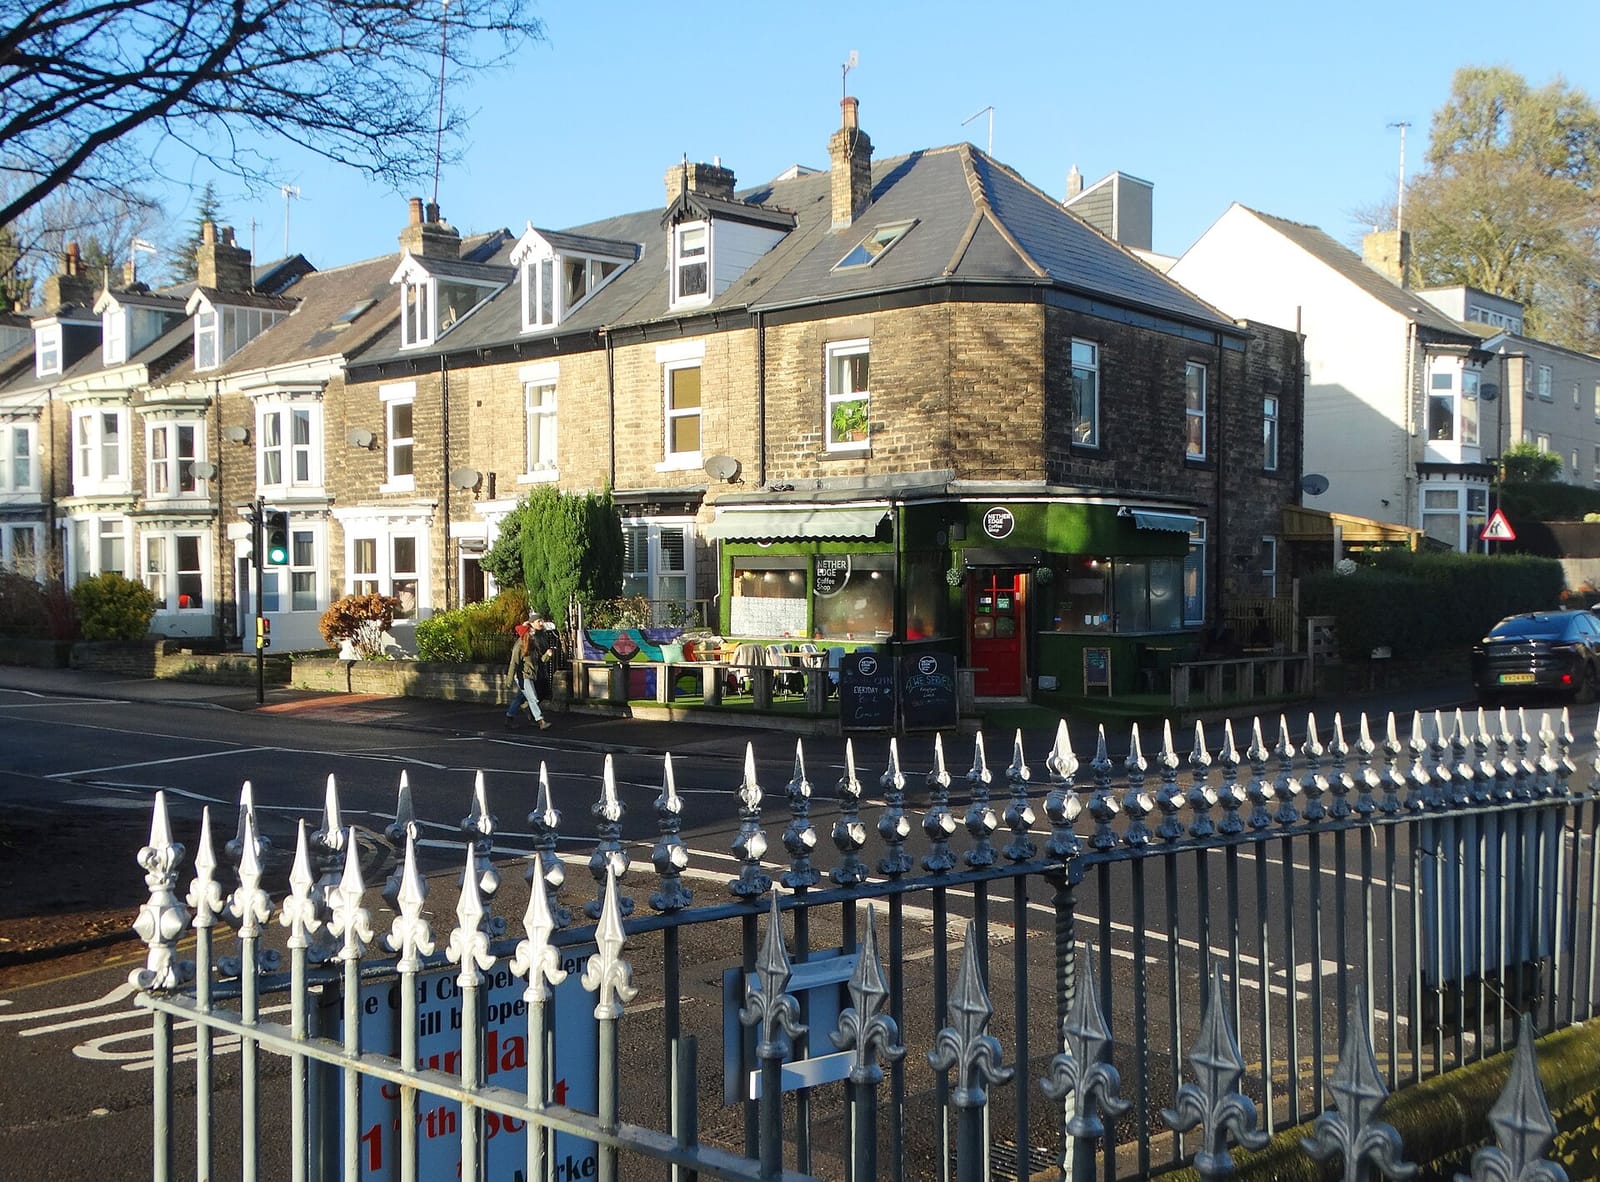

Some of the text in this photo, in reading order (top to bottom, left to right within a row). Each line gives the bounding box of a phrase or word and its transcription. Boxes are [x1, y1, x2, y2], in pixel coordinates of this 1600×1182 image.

[817, 560, 847, 569] NETHER
[817, 568, 837, 577] EDGE
[816, 577, 835, 585] Coffee
[816, 584, 831, 592] Shop
[436, 968, 514, 1001] Chel
[487, 998, 529, 1025] ope
[360, 1105, 456, 1173] 1th
